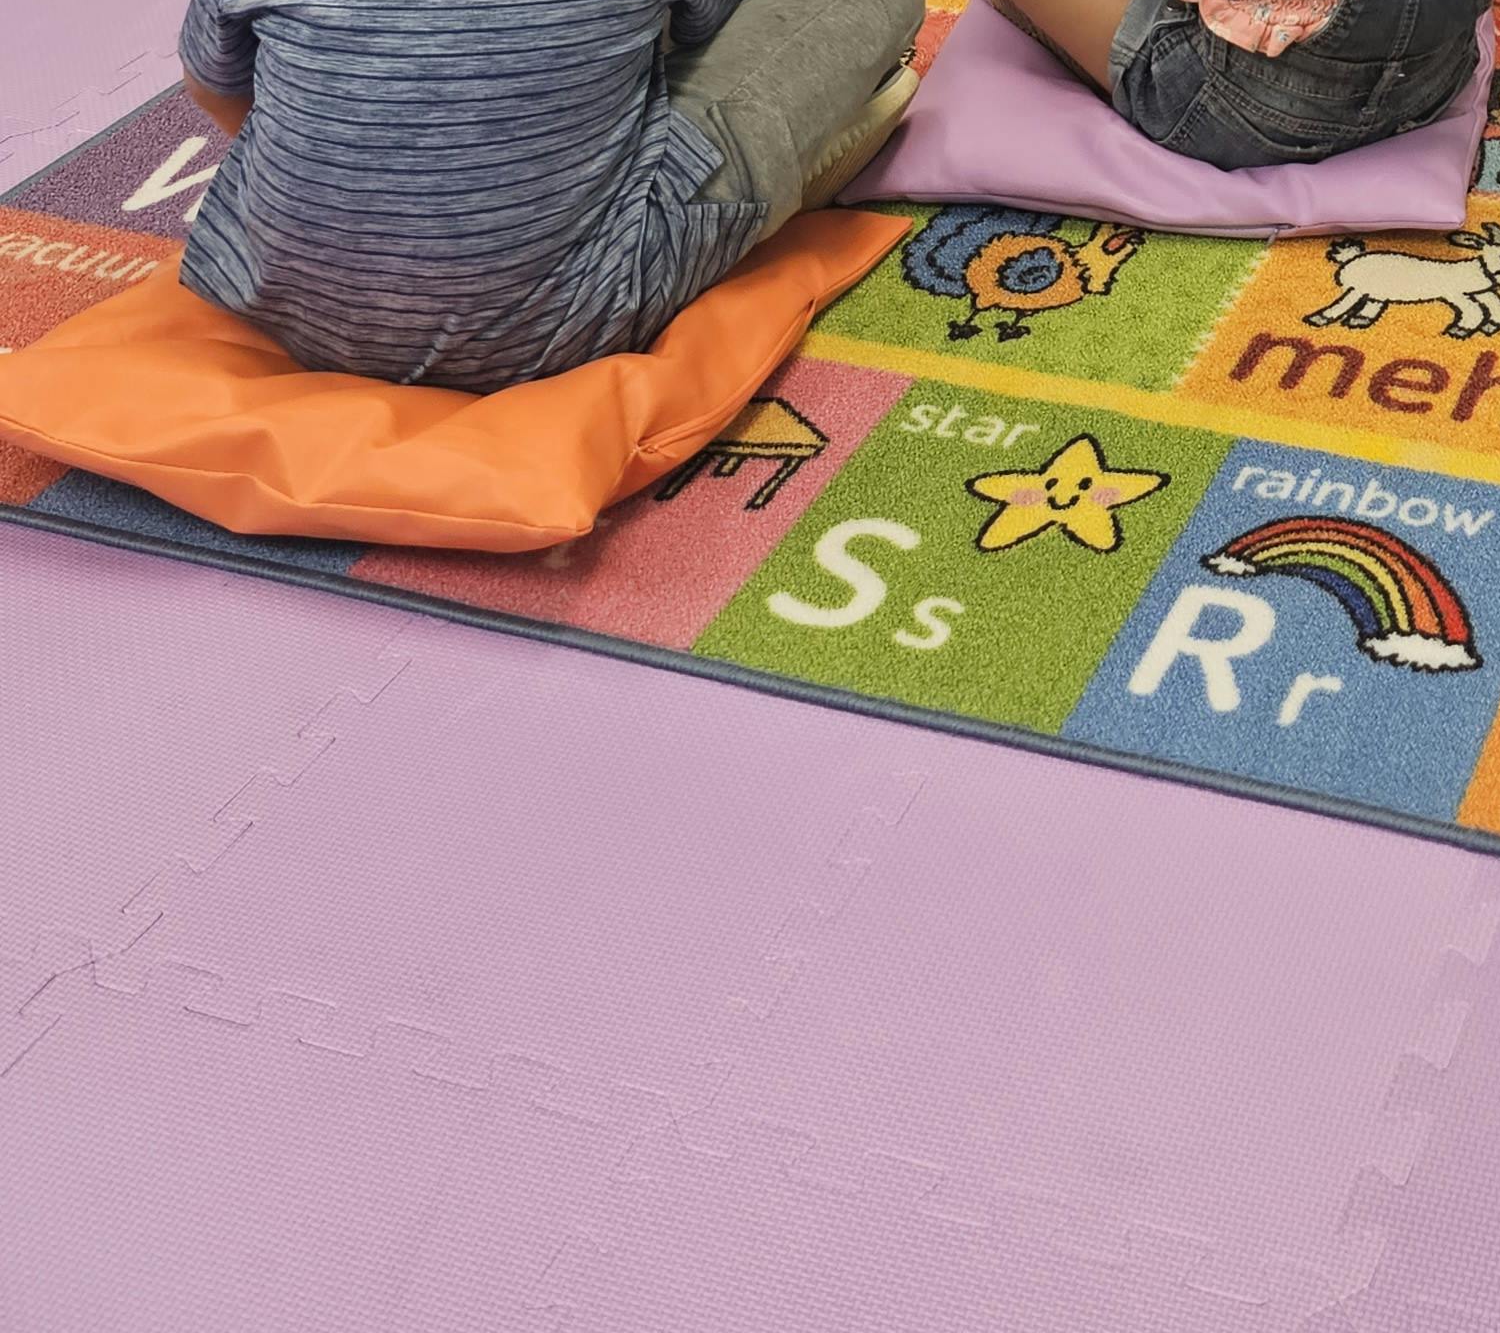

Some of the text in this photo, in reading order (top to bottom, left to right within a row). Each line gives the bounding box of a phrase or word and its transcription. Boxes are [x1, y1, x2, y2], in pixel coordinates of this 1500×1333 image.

[900, 396, 1041, 450] star
[1232, 459, 1495, 539] rainbow
[766, 518, 968, 651] S s
[1127, 583, 1344, 731] R r
